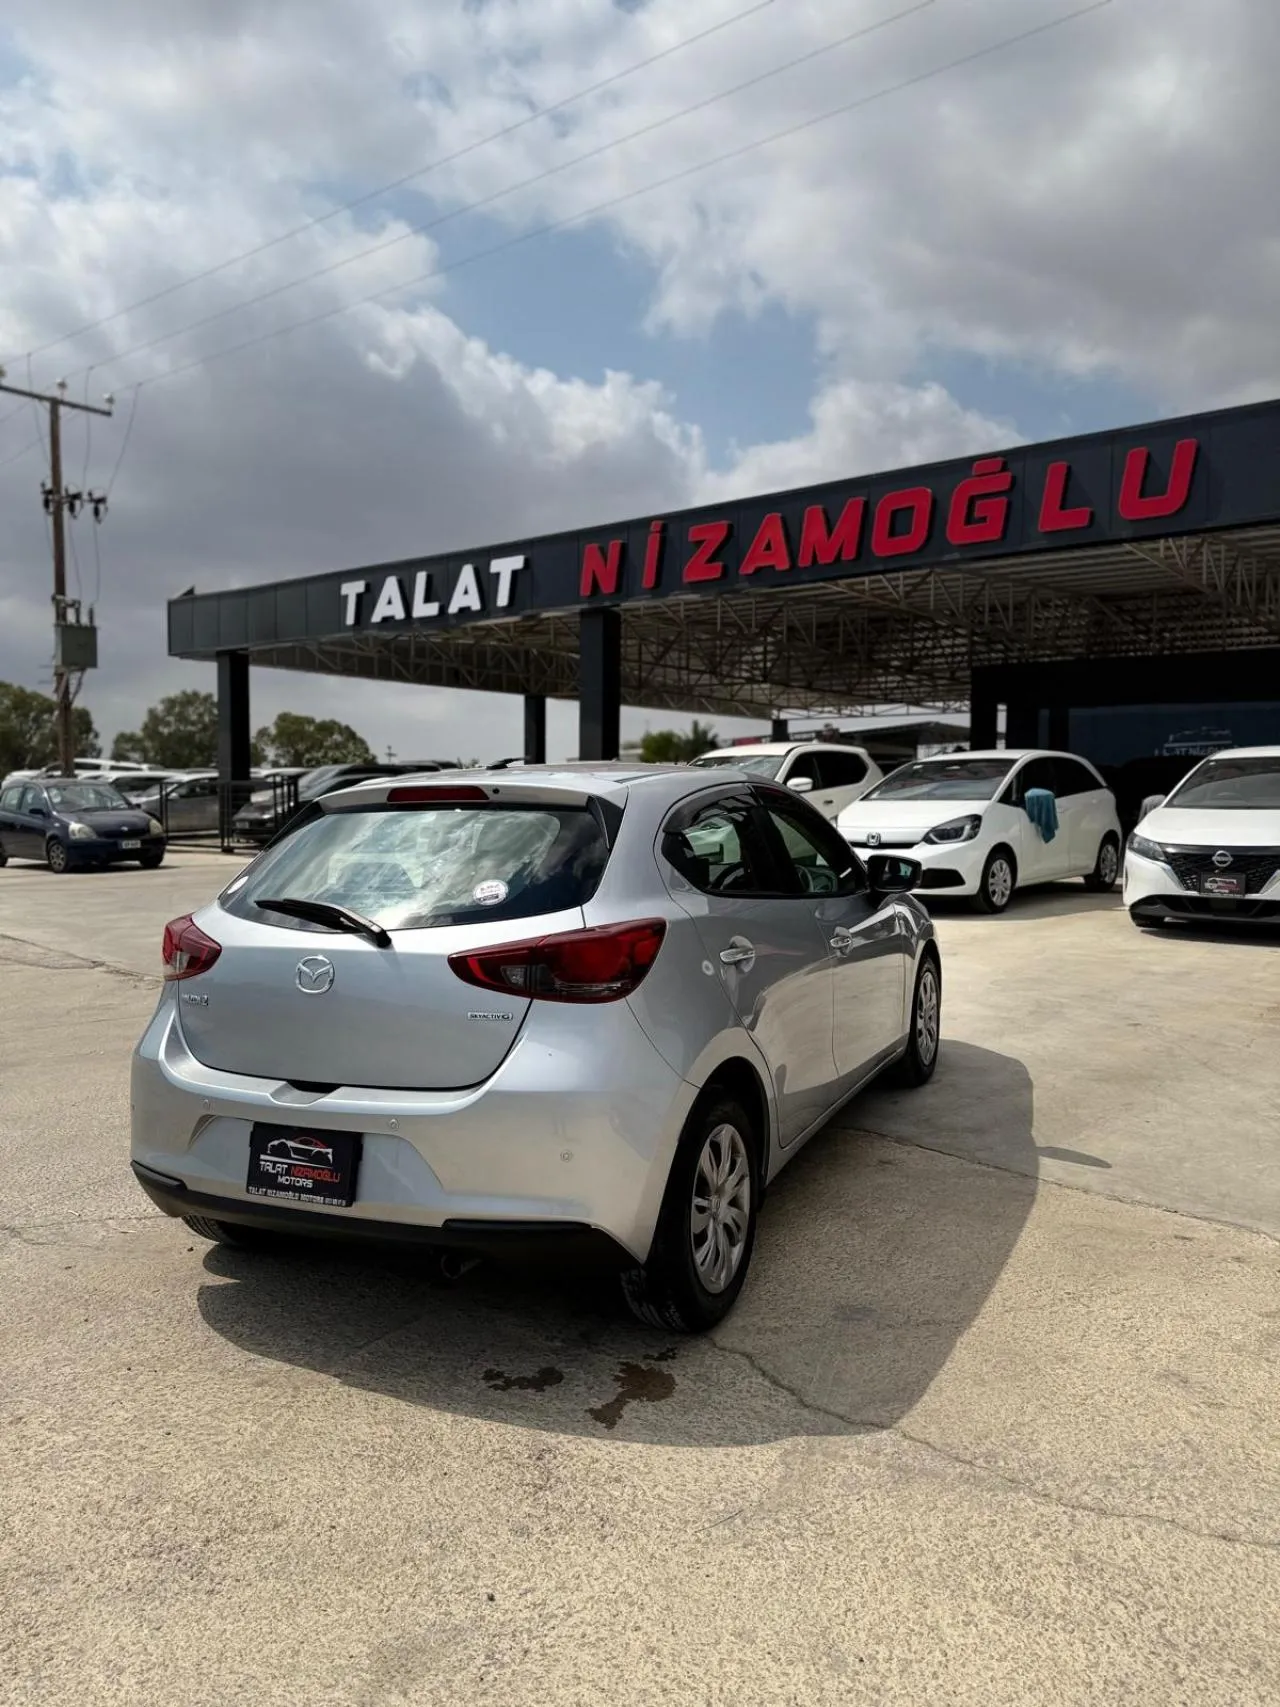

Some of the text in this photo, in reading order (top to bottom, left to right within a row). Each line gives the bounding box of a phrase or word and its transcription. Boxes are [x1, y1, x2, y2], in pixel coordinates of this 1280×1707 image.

[340, 438, 1198, 626] TALAT NİZAMOĞLU
[259, 1161, 288, 1175] TALAT
[277, 1175, 313, 1188] MOTORS
